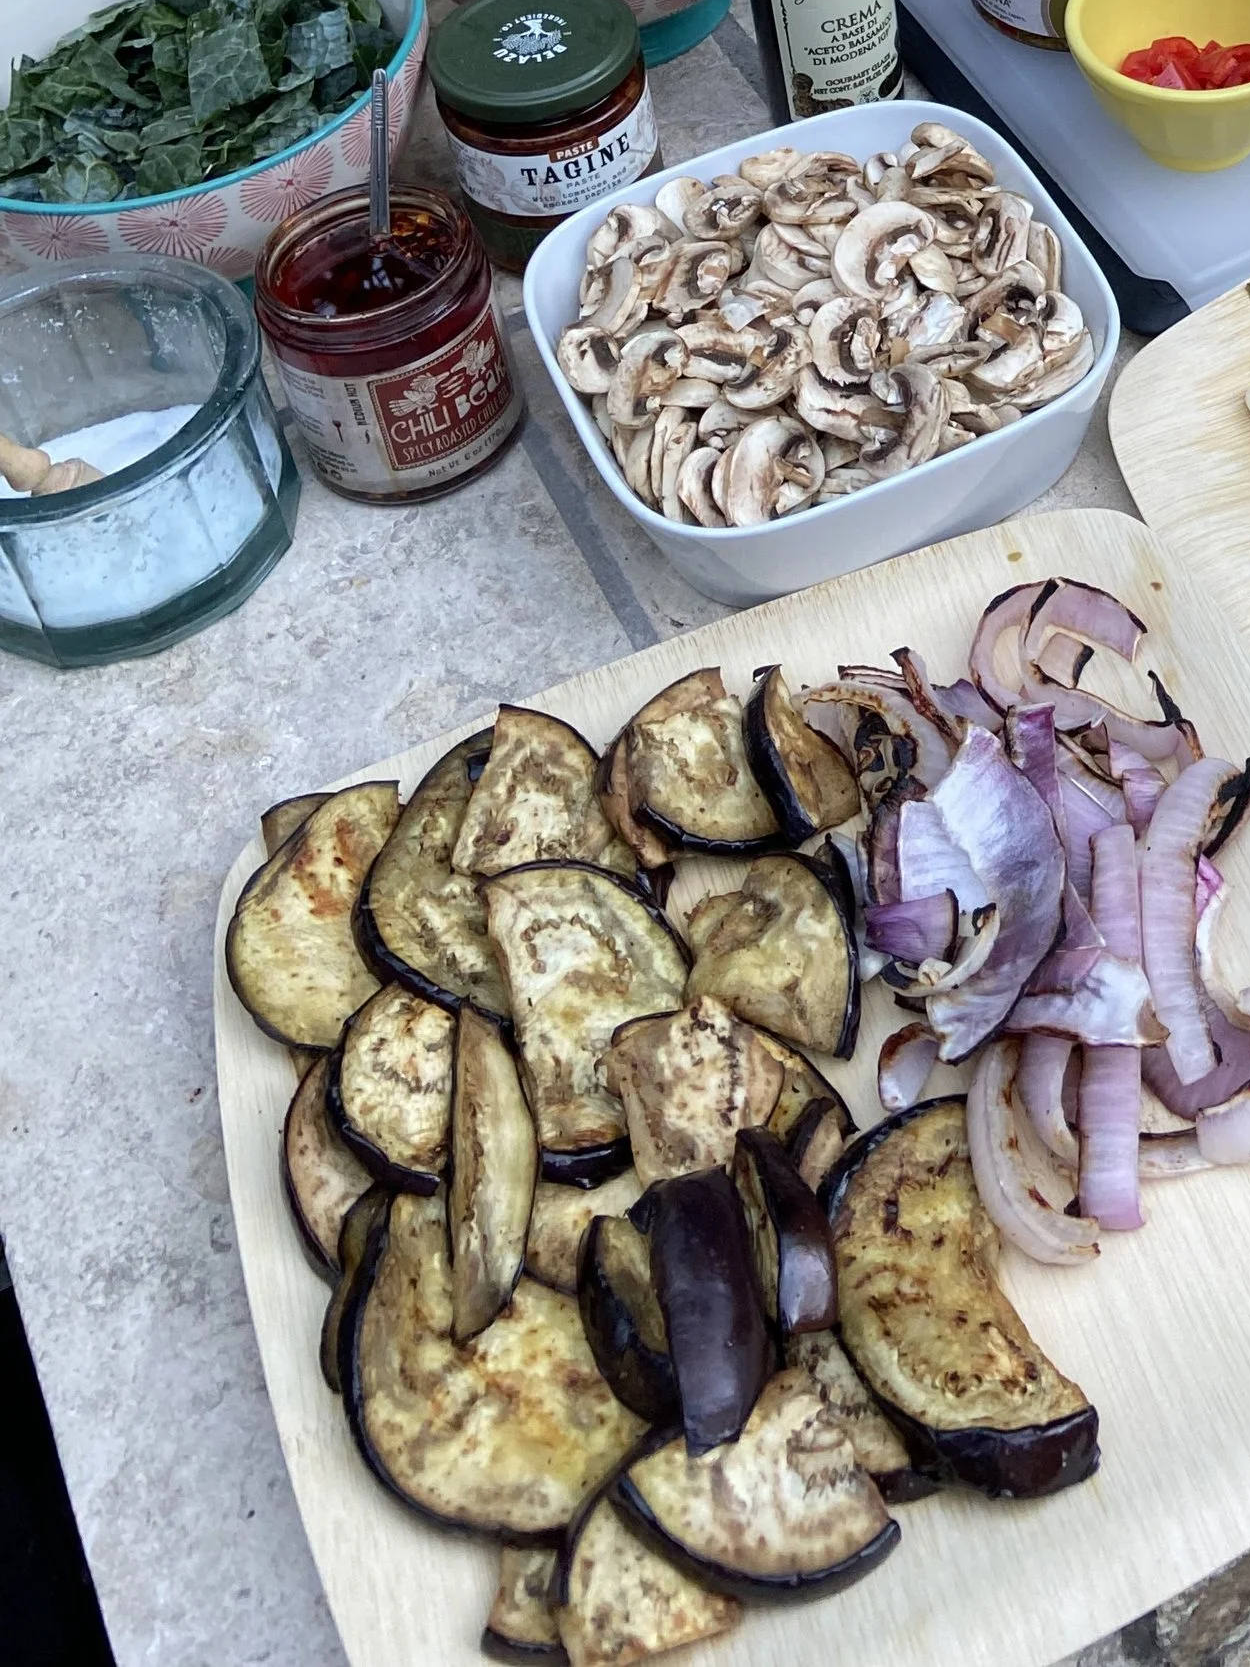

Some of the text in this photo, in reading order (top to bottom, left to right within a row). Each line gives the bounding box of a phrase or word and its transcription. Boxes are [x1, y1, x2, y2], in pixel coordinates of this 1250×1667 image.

[515, 13, 567, 26] INGREDIENT
[821, 0, 882, 33] CREMA
[831, 17, 878, 43] A BASE DI
[849, 11, 893, 49] BALSAMICO
[493, 44, 568, 64] BELAZU
[813, 57, 826, 66] DI
[830, 42, 877, 65] MODENA
[825, 67, 870, 86] GOURMET
[520, 132, 630, 186] TAGINE
[556, 141, 594, 160] PASTE
[543, 179, 622, 208] smoked paprika
[562, 180, 607, 199] tomatoes
[612, 166, 626, 180] and
[566, 172, 600, 189] PASTE
[344, 382, 358, 398] HOT
[390, 405, 451, 444] CHILI
[402, 441, 434, 462] SPICY
[435, 417, 477, 452] ROASTED
